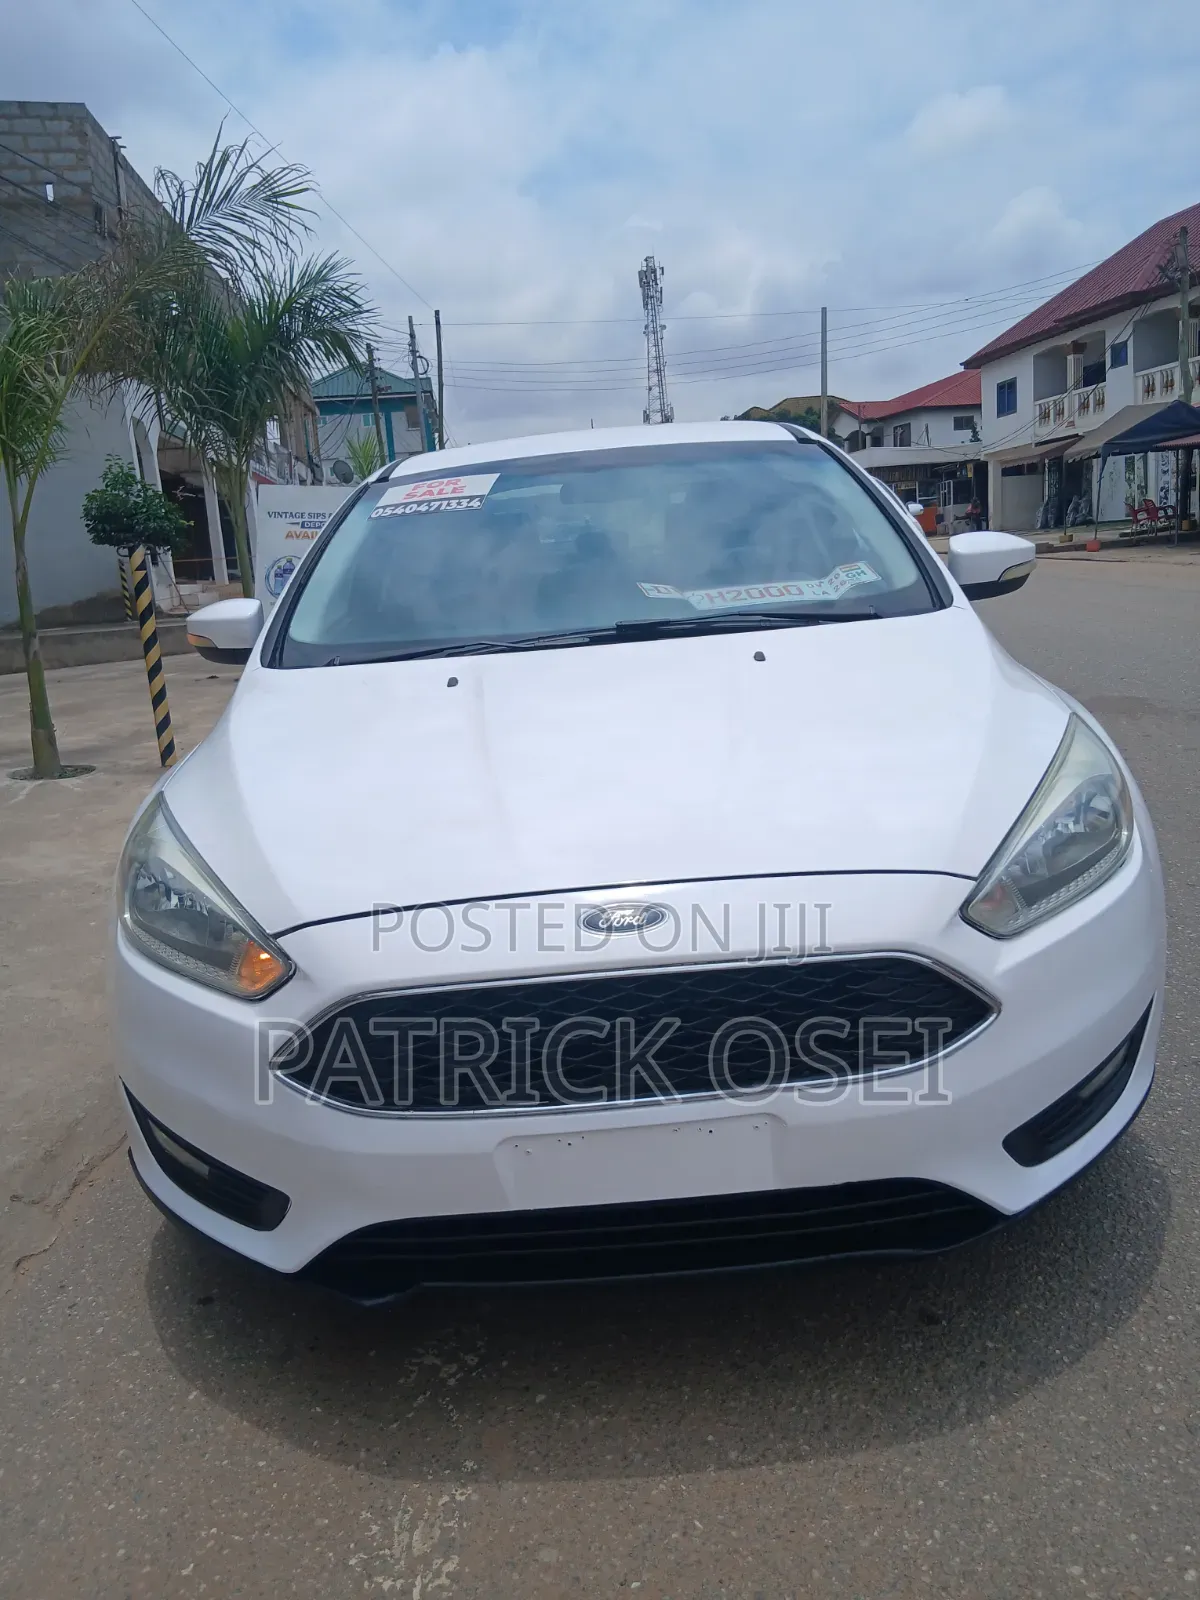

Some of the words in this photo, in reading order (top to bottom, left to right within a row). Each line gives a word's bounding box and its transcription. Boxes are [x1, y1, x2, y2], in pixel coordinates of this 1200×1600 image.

[412, 478, 461, 491] FOR
[403, 486, 467, 500] SALE
[371, 498, 481, 518] 0540471334
[267, 511, 306, 519] VINTAGE
[307, 512, 327, 520] SIPS
[845, 569, 868, 579] GH
[598, 909, 648, 928] Ford
